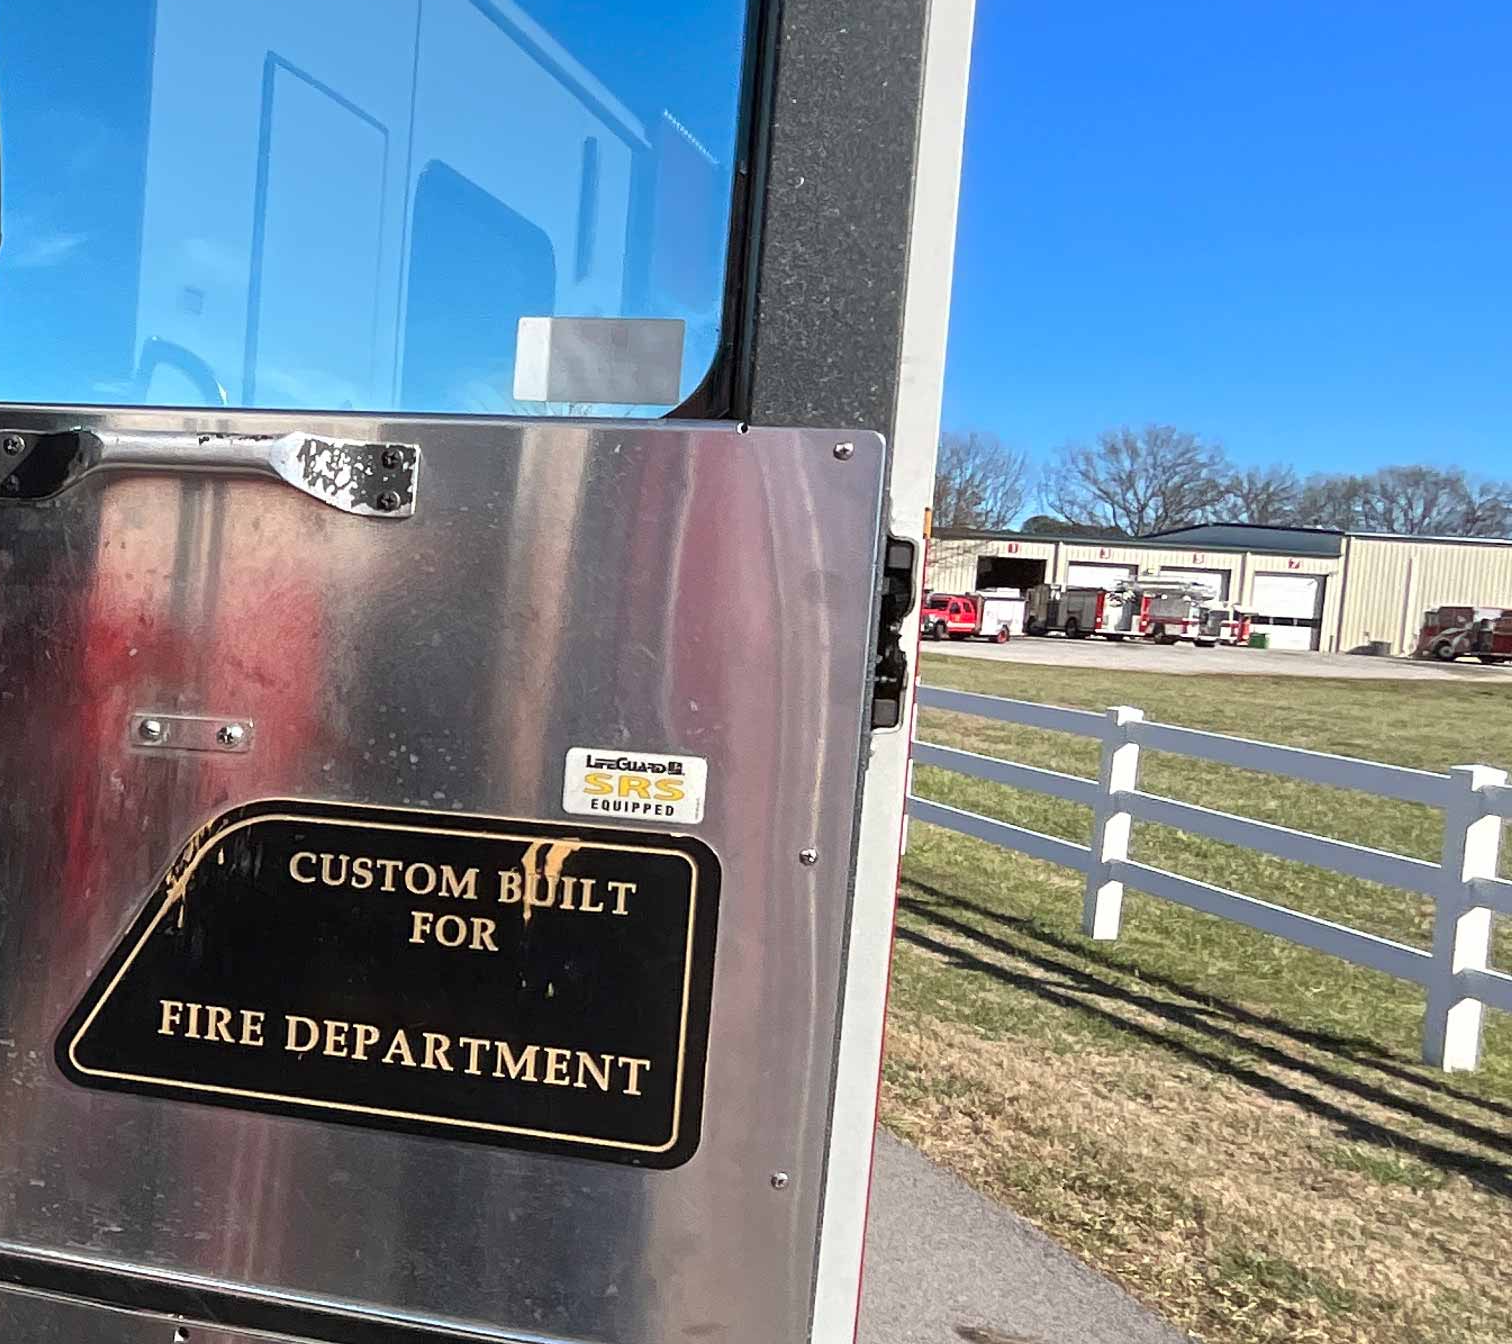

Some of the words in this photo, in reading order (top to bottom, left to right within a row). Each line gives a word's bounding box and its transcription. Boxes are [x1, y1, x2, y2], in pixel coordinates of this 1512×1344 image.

[583, 772, 686, 802] SRS
[590, 798, 675, 817] EQUIPPED
[289, 851, 480, 900] CUSTOM
[497, 869, 638, 916] BUILT
[409, 910, 499, 952] FOR
[157, 999, 266, 1047] FIRE
[284, 1014, 652, 1096] DEPARTMENT
